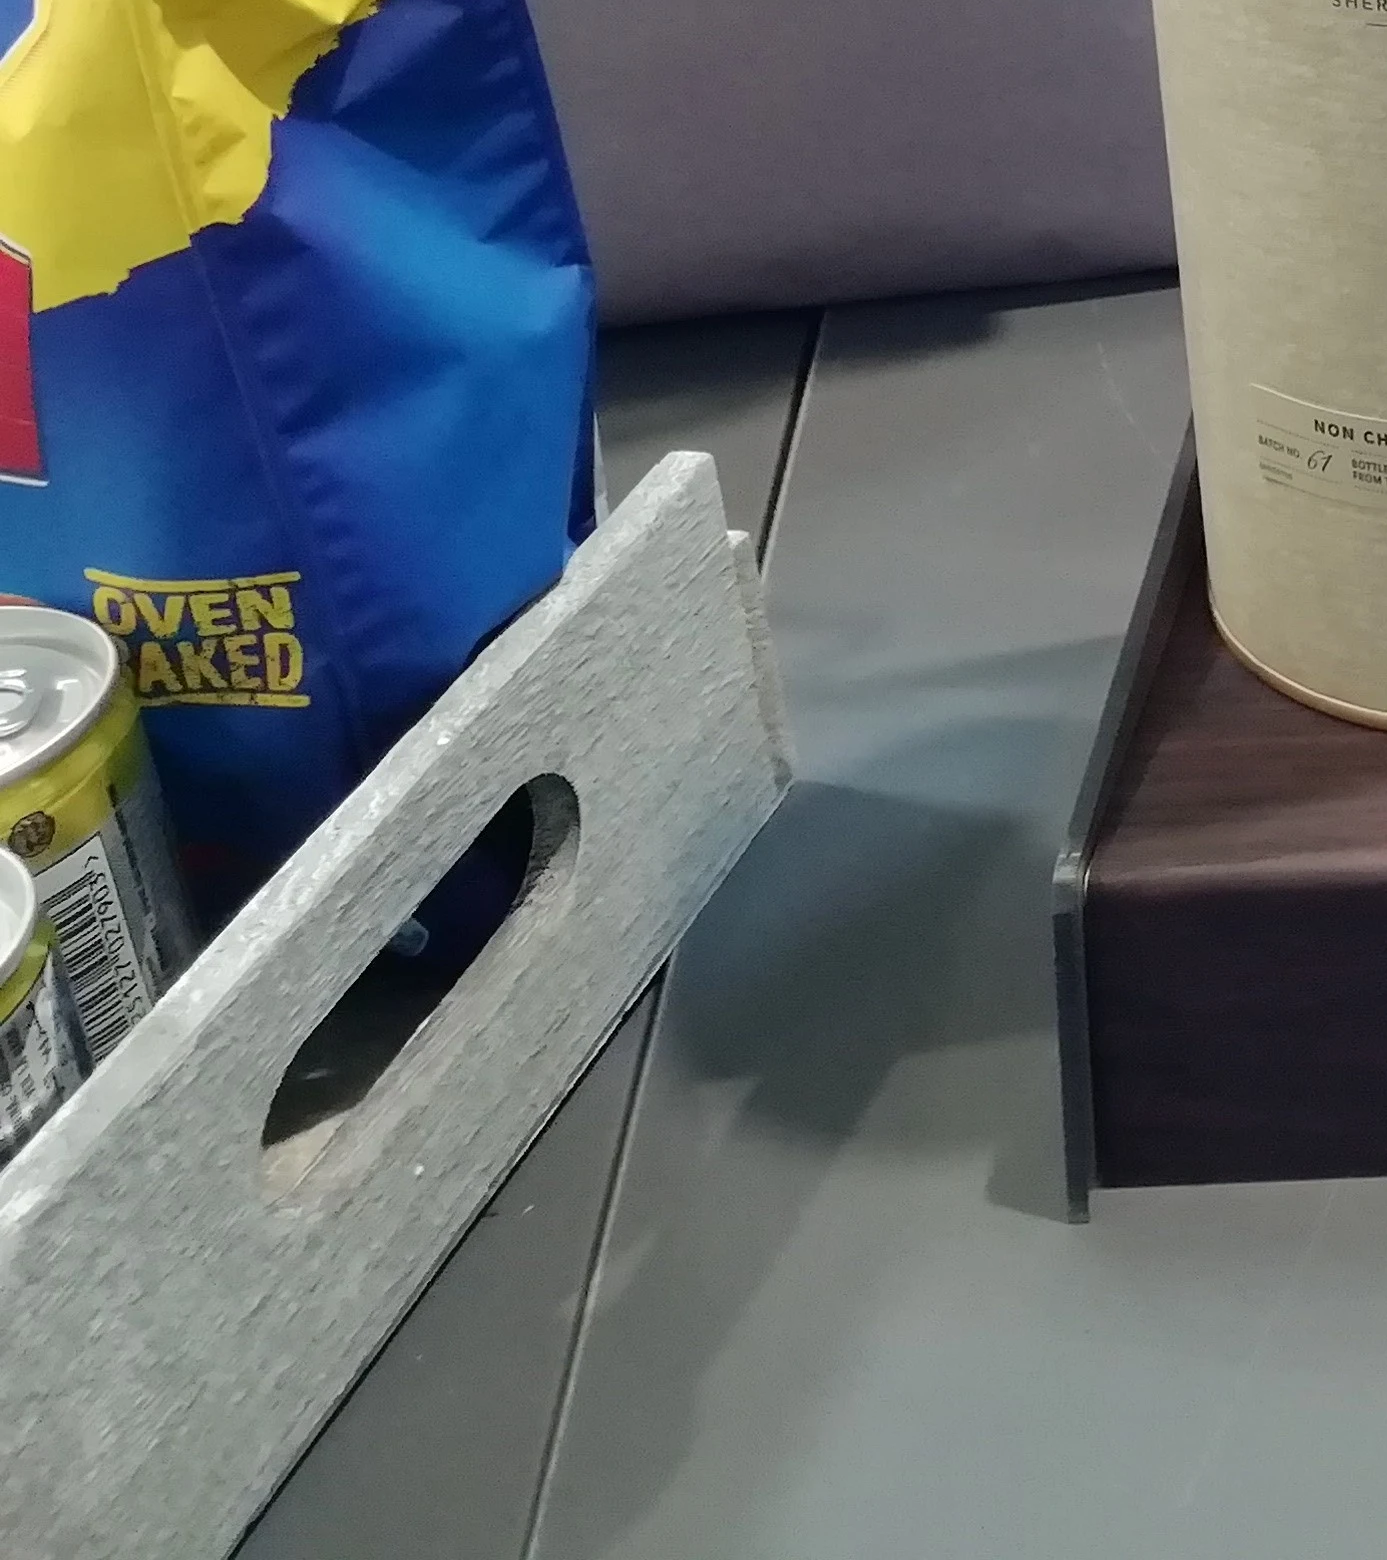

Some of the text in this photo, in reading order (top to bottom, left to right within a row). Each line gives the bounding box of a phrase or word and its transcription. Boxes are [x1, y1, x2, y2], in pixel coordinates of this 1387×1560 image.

[1314, 419, 1354, 441] NON
[1352, 471, 1382, 485] FROM
[93, 586, 295, 638] OVEN
[116, 633, 304, 694] AKED
